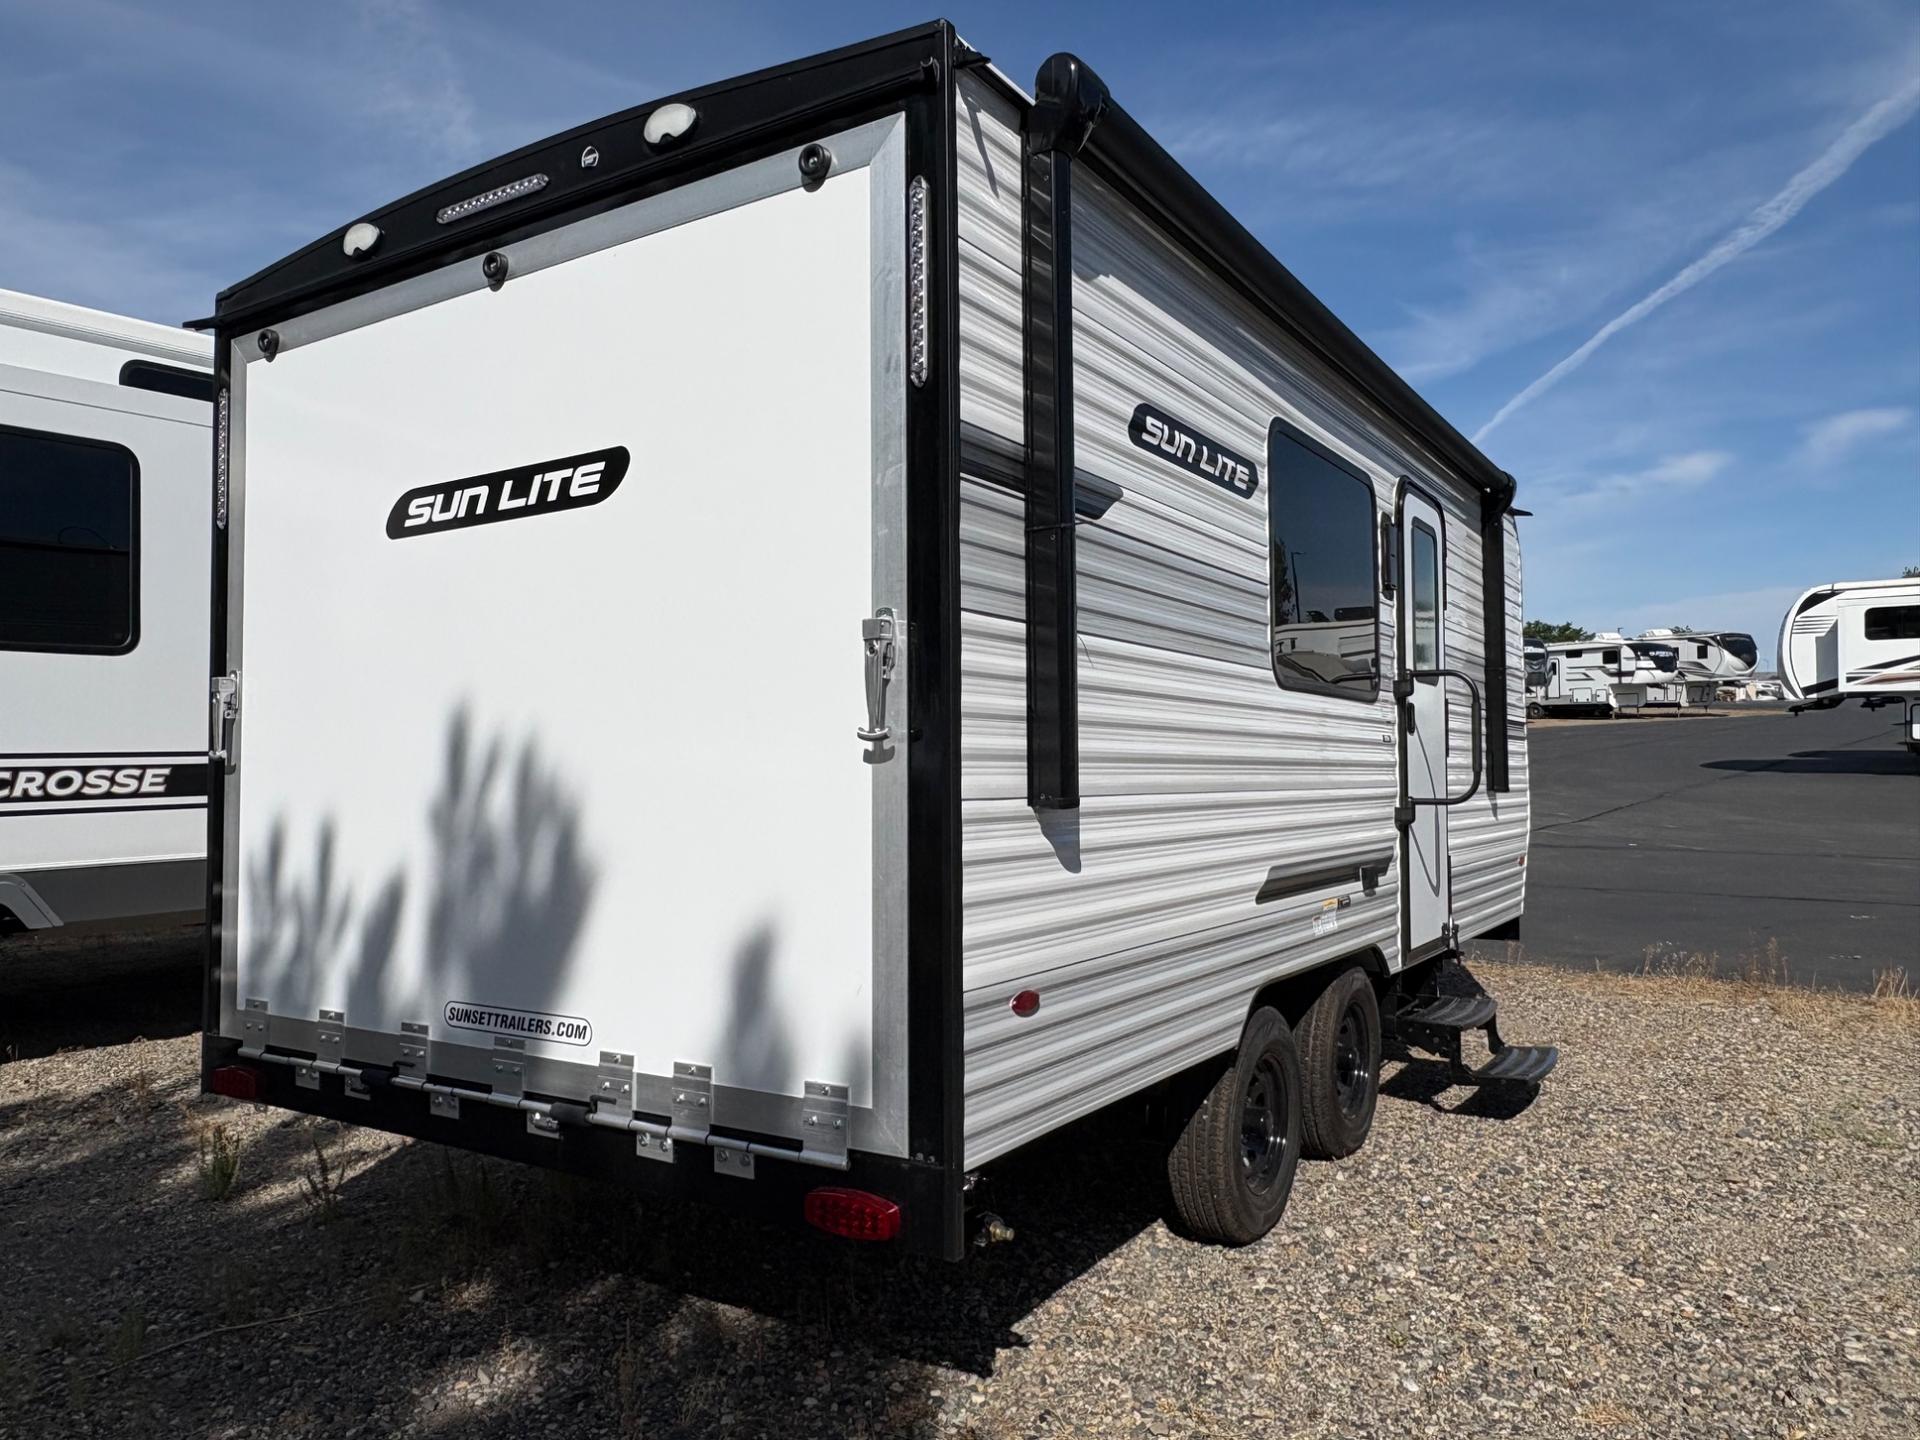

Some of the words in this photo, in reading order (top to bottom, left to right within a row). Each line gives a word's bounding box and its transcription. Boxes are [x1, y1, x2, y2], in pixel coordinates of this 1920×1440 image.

[1141, 415, 1196, 463] SUN
[1199, 445, 1250, 490] LITE
[404, 485, 489, 527] SUN
[498, 461, 606, 511] LITE
[448, 1007, 587, 1040] SUNSETTRAILERS.COM
